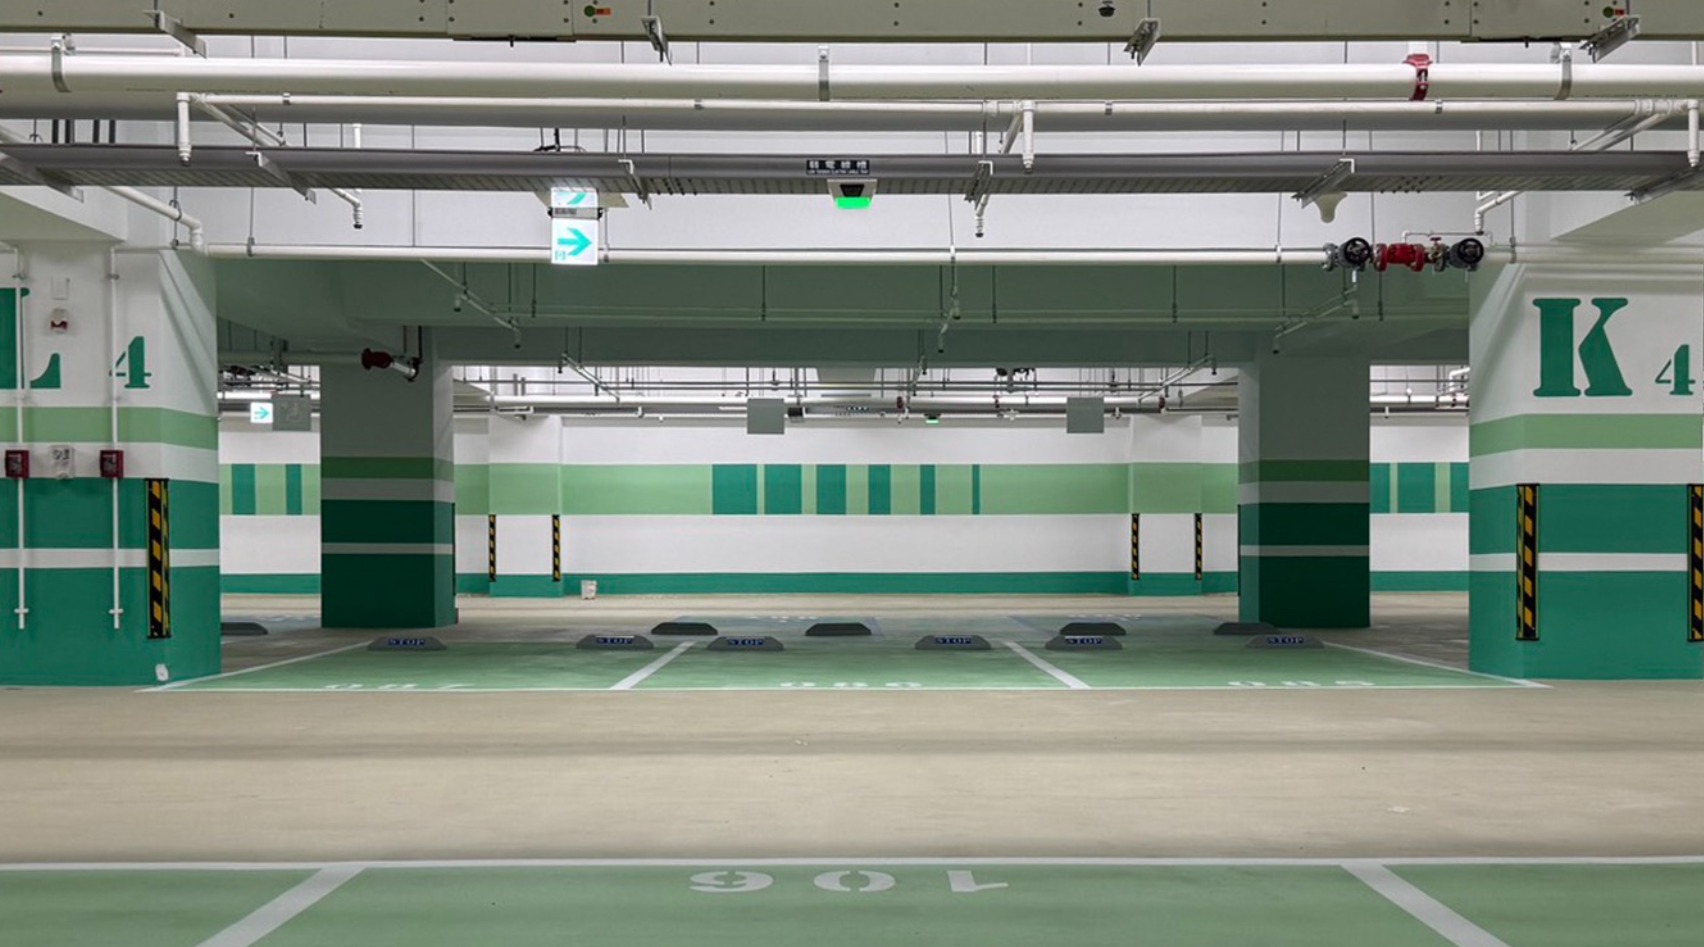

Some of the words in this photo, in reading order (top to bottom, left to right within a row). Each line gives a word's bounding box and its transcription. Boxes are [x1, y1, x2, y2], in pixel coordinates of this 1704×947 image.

[0, 287, 61, 389] L
[109, 336, 152, 389] 4
[1532, 298, 1633, 397] K
[1654, 344, 1696, 395] 4
[389, 638, 425, 646] STOP
[597, 637, 632, 645] STOP
[1268, 636, 1304, 644] STOP
